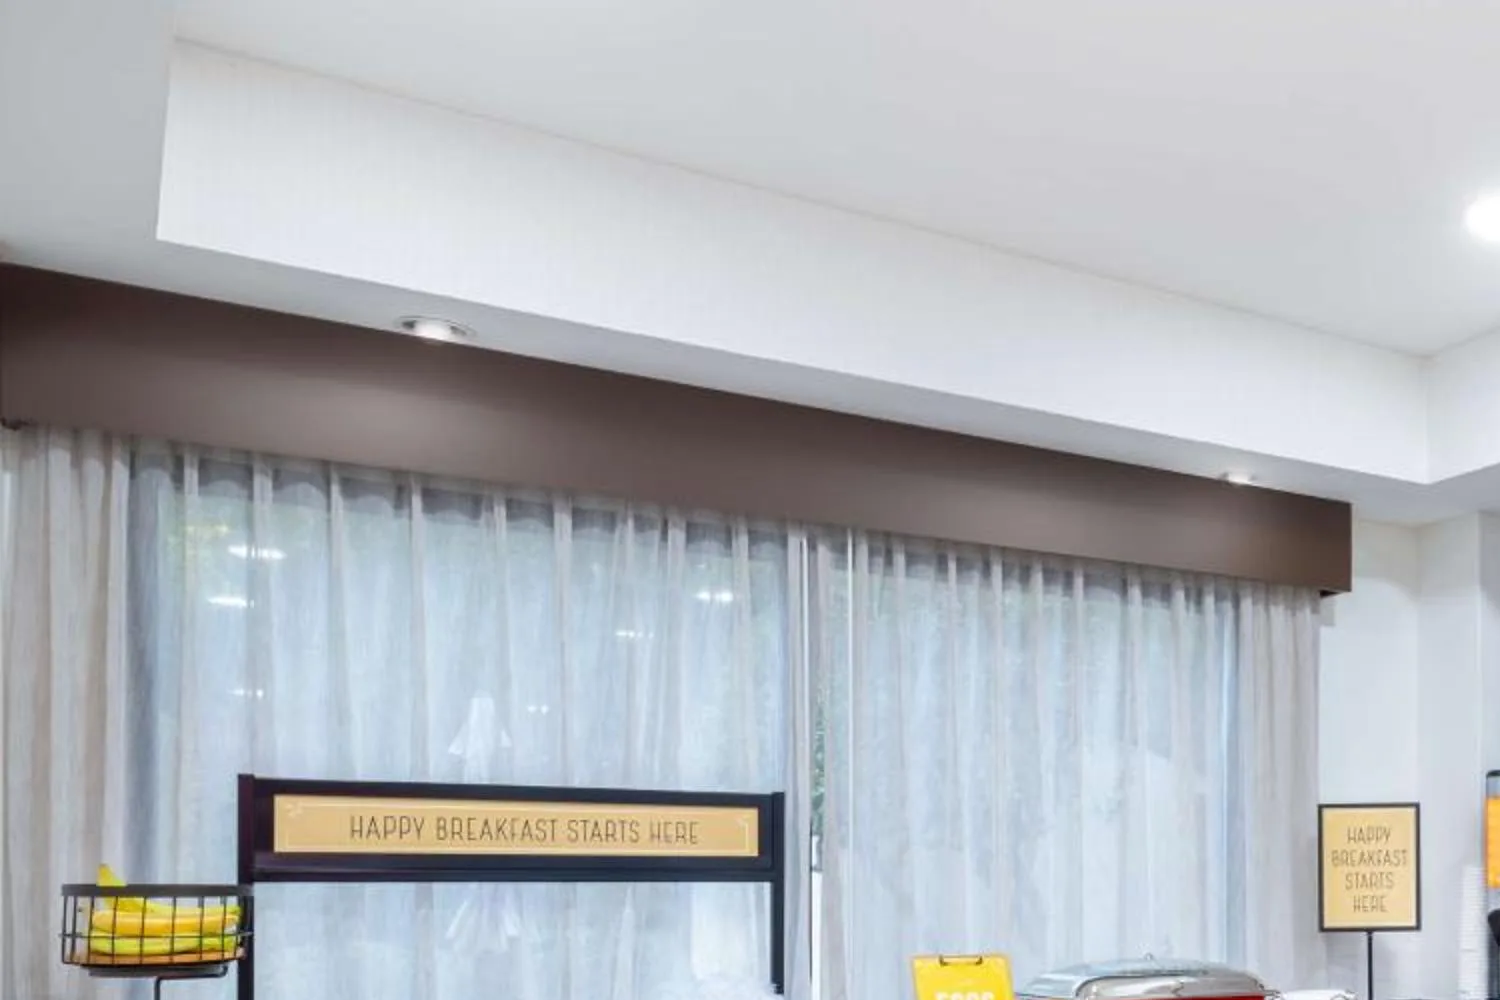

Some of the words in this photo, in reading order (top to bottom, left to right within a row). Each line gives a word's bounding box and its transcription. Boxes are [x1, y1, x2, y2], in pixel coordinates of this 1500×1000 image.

[350, 815, 425, 841] HAPPY
[435, 815, 558, 842] BREAKFAST
[566, 818, 641, 843] STARTS
[649, 820, 700, 845] HERE
[1346, 825, 1392, 845] HAPPY
[1331, 849, 1407, 869] BREAKFAST
[1345, 871, 1395, 891] STARTS
[1353, 894, 1390, 913] HERE
